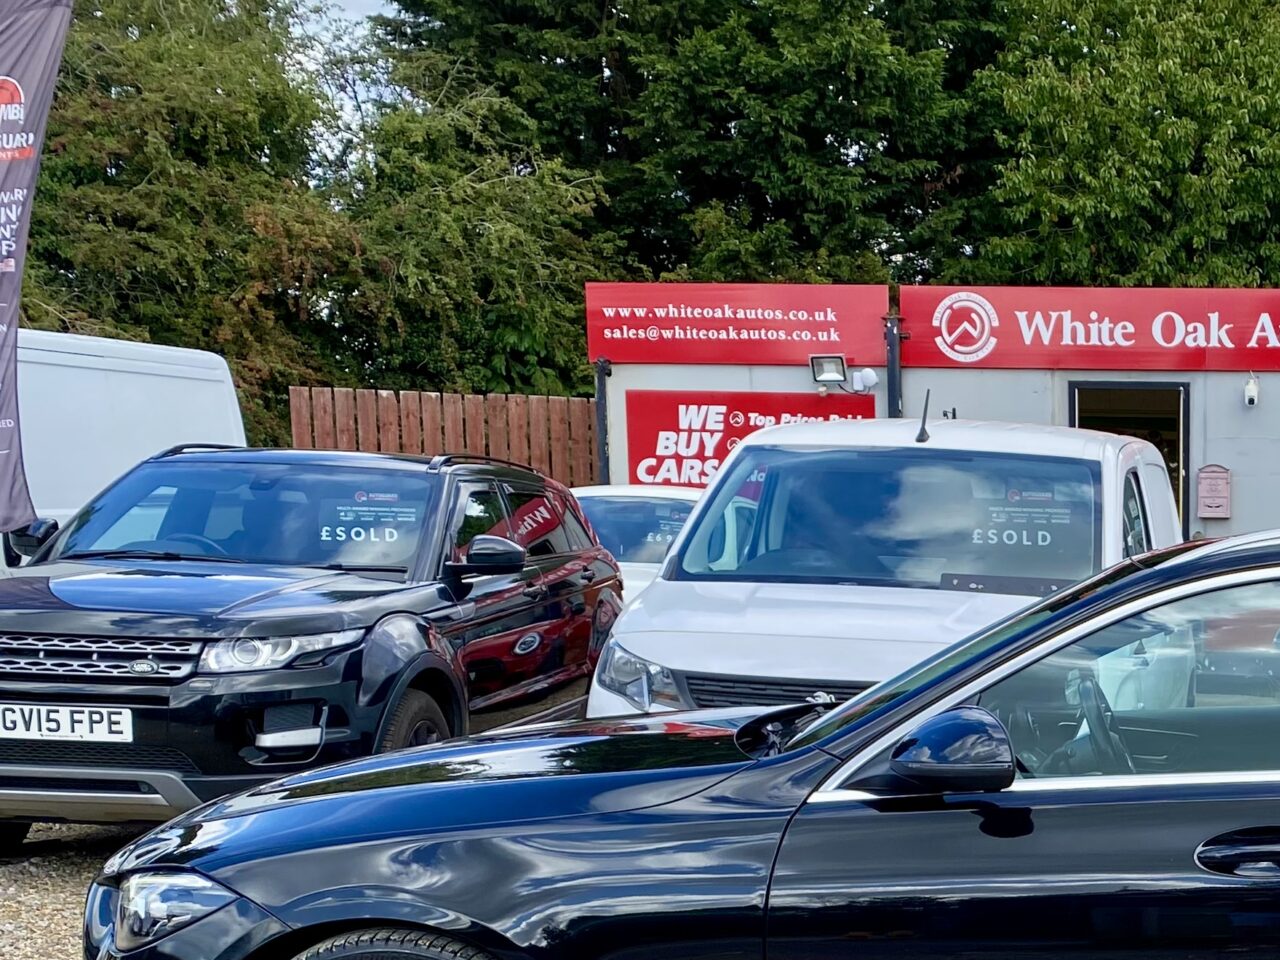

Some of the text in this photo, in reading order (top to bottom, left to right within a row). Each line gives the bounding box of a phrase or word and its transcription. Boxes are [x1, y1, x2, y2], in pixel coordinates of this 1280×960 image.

[601, 304, 837, 321] www.whiteoakautos.co.uk
[603, 325, 840, 341] sales@whiteoakautos.co.uk
[1014, 309, 1136, 347] White
[1152, 311, 1235, 348] Oak
[678, 404, 727, 431] WE
[748, 412, 776, 427] Top
[656, 430, 723, 457] BUY
[636, 458, 719, 484] CARS
[321, 526, 398, 542] £SOLD
[972, 529, 1051, 546] £SOLD
[1, 707, 124, 734] GV15 FPE
